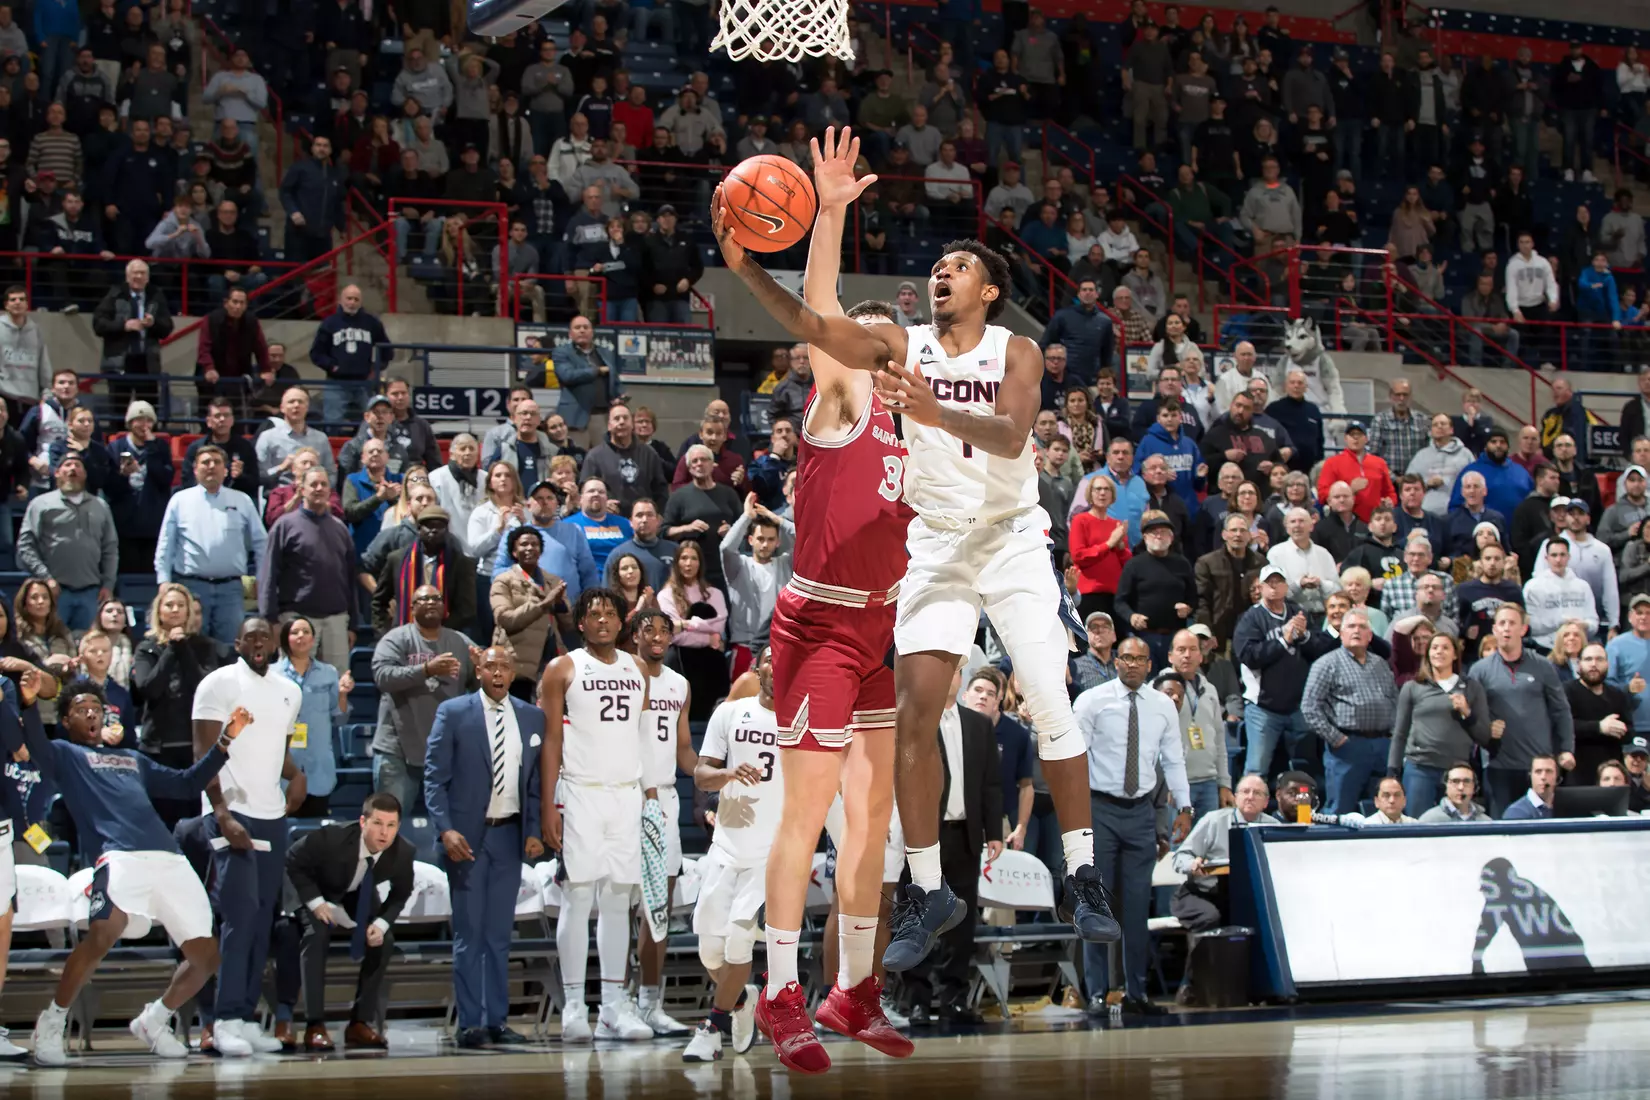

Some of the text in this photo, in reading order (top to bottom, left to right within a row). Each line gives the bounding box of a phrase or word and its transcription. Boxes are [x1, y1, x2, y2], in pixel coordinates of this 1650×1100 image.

[415, 389, 502, 416] SEC 12
[925, 376, 1000, 403] CON
[582, 680, 642, 691] UCONN
[600, 695, 630, 722] 25
[649, 699, 684, 711] CONN
[657, 715, 669, 742] 5
[735, 729, 779, 746] UCO
[758, 751, 775, 782] 3
